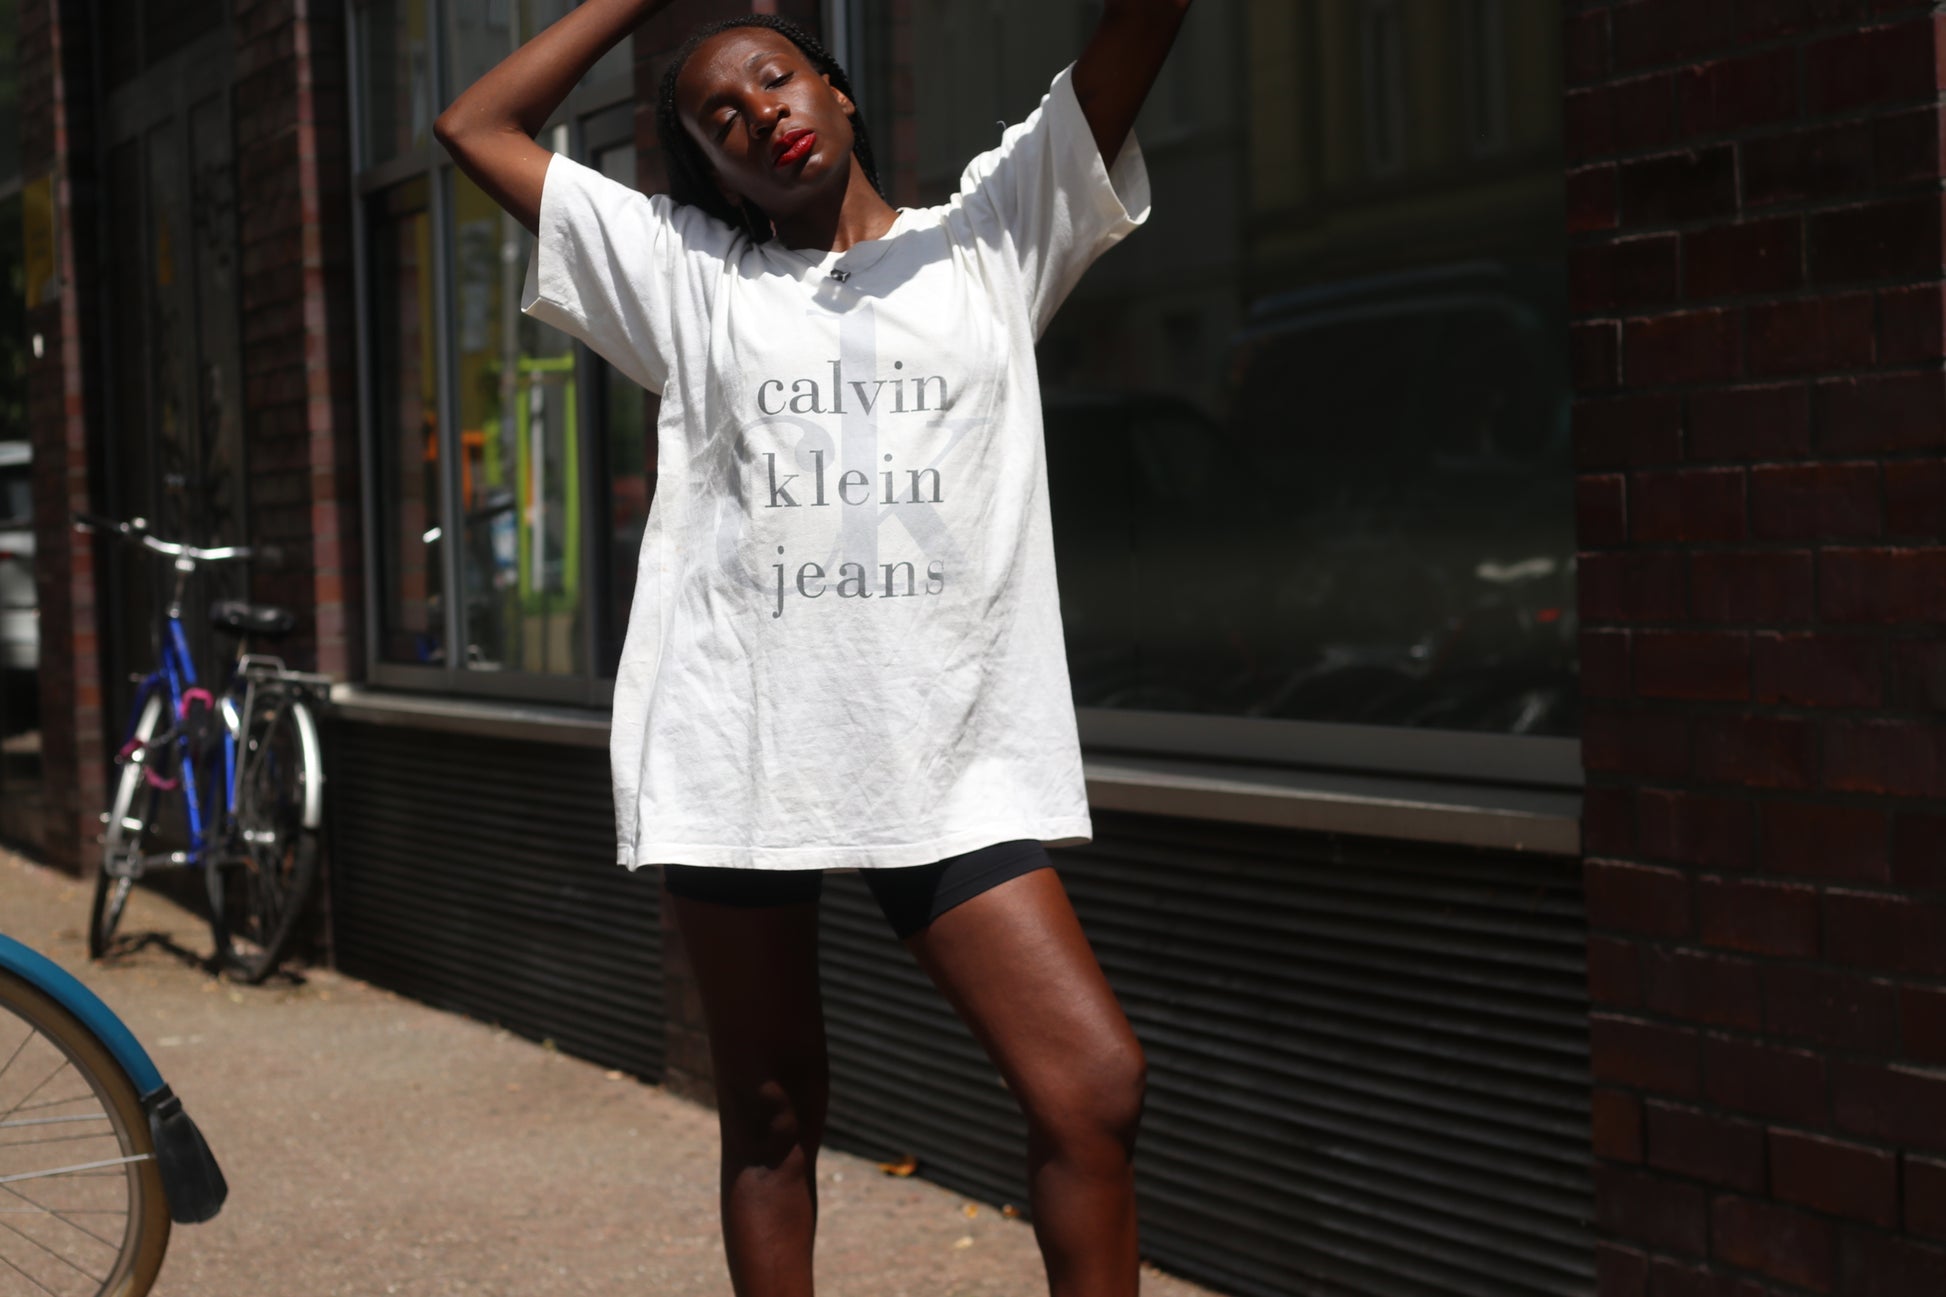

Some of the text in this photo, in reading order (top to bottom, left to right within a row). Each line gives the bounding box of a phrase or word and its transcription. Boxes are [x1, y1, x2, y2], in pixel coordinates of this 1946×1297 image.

[757, 359, 949, 416] calvin
[762, 449, 945, 508] klein
[771, 545, 946, 619] jeans
